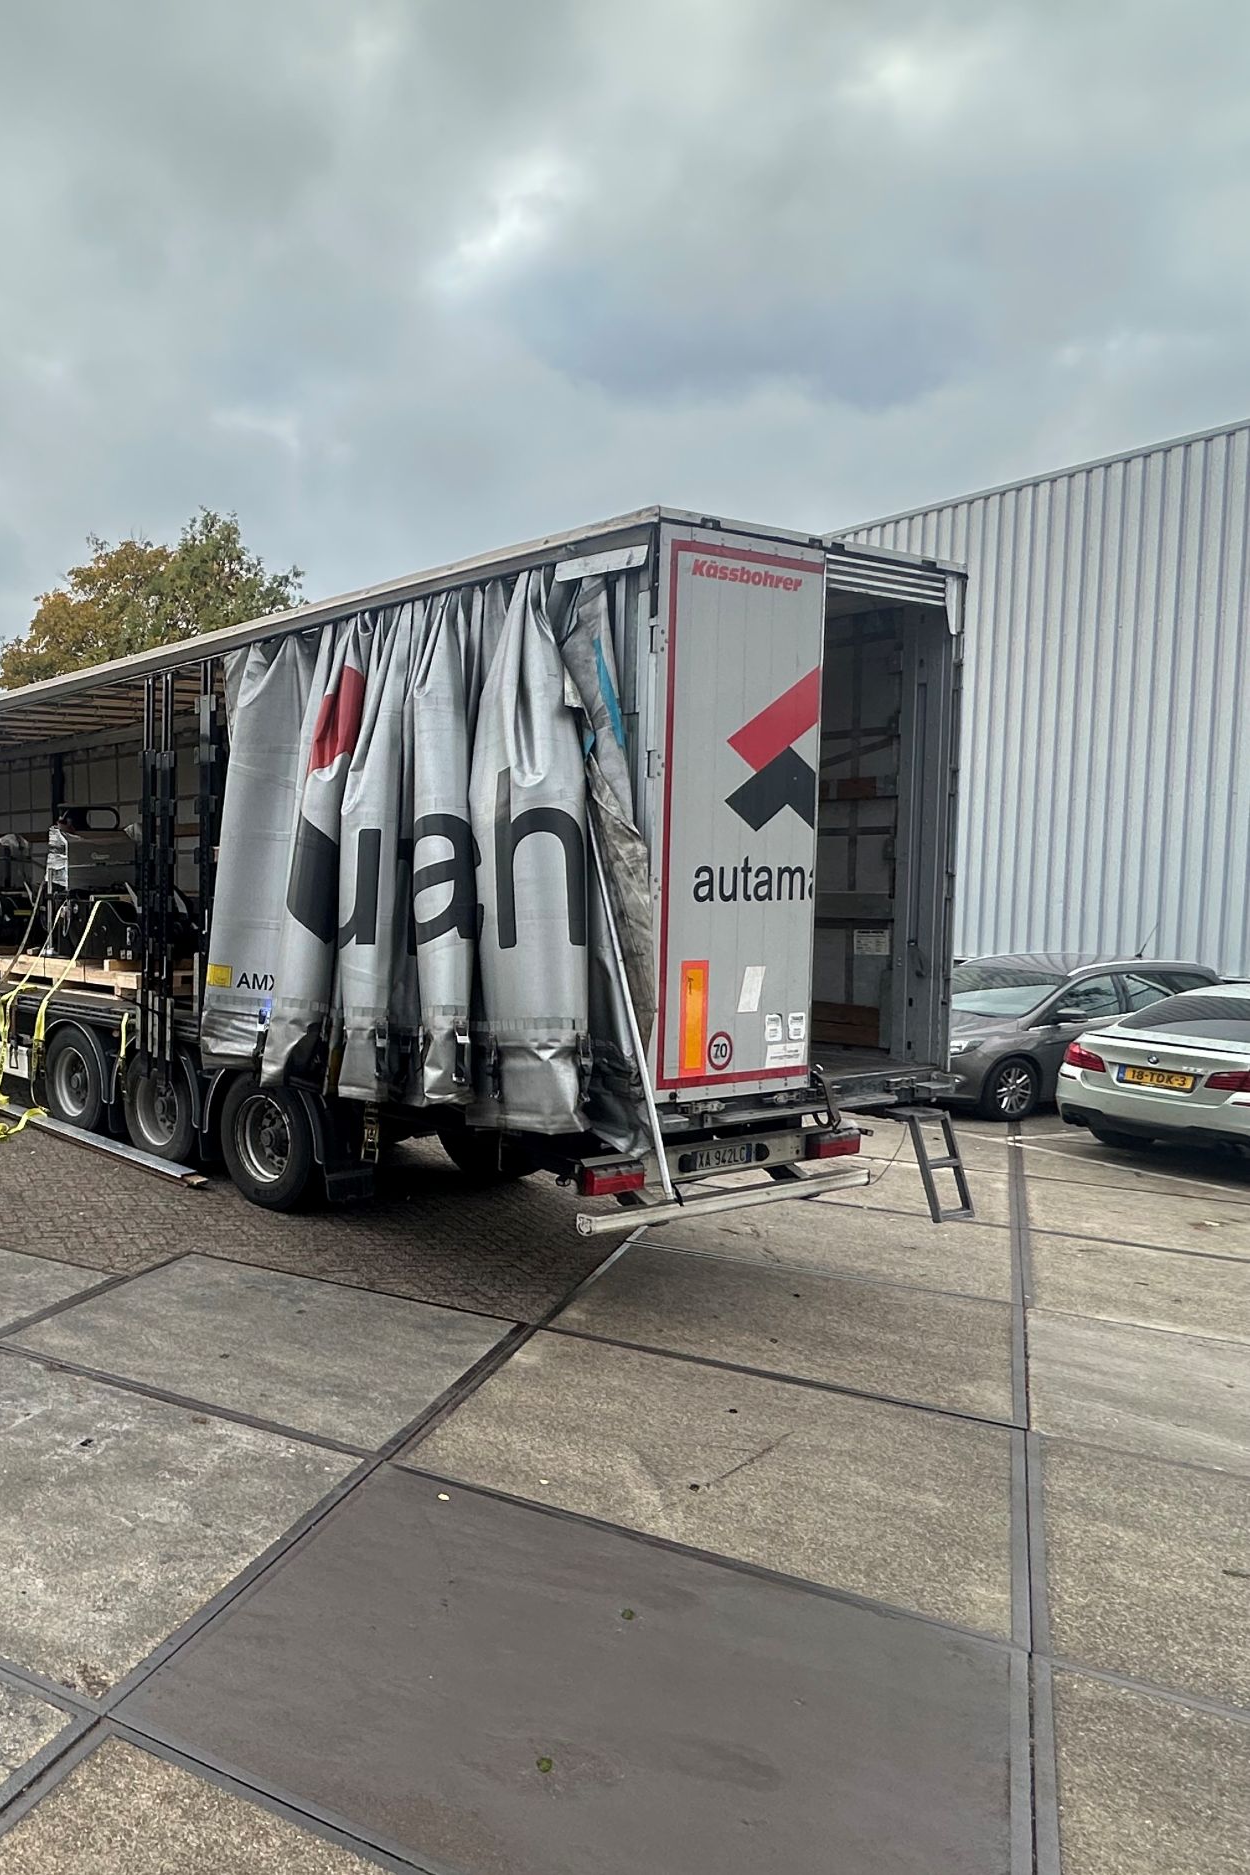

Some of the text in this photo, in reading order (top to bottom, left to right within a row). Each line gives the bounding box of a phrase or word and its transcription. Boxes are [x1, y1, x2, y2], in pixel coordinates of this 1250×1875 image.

[692, 559, 803, 592] Kässbohrer
[693, 855, 813, 902] autam
[713, 1043, 728, 1059] 70
[1131, 1069, 1186, 1086] 18-TDK-3
[698, 1146, 746, 1168] XA 942LC
